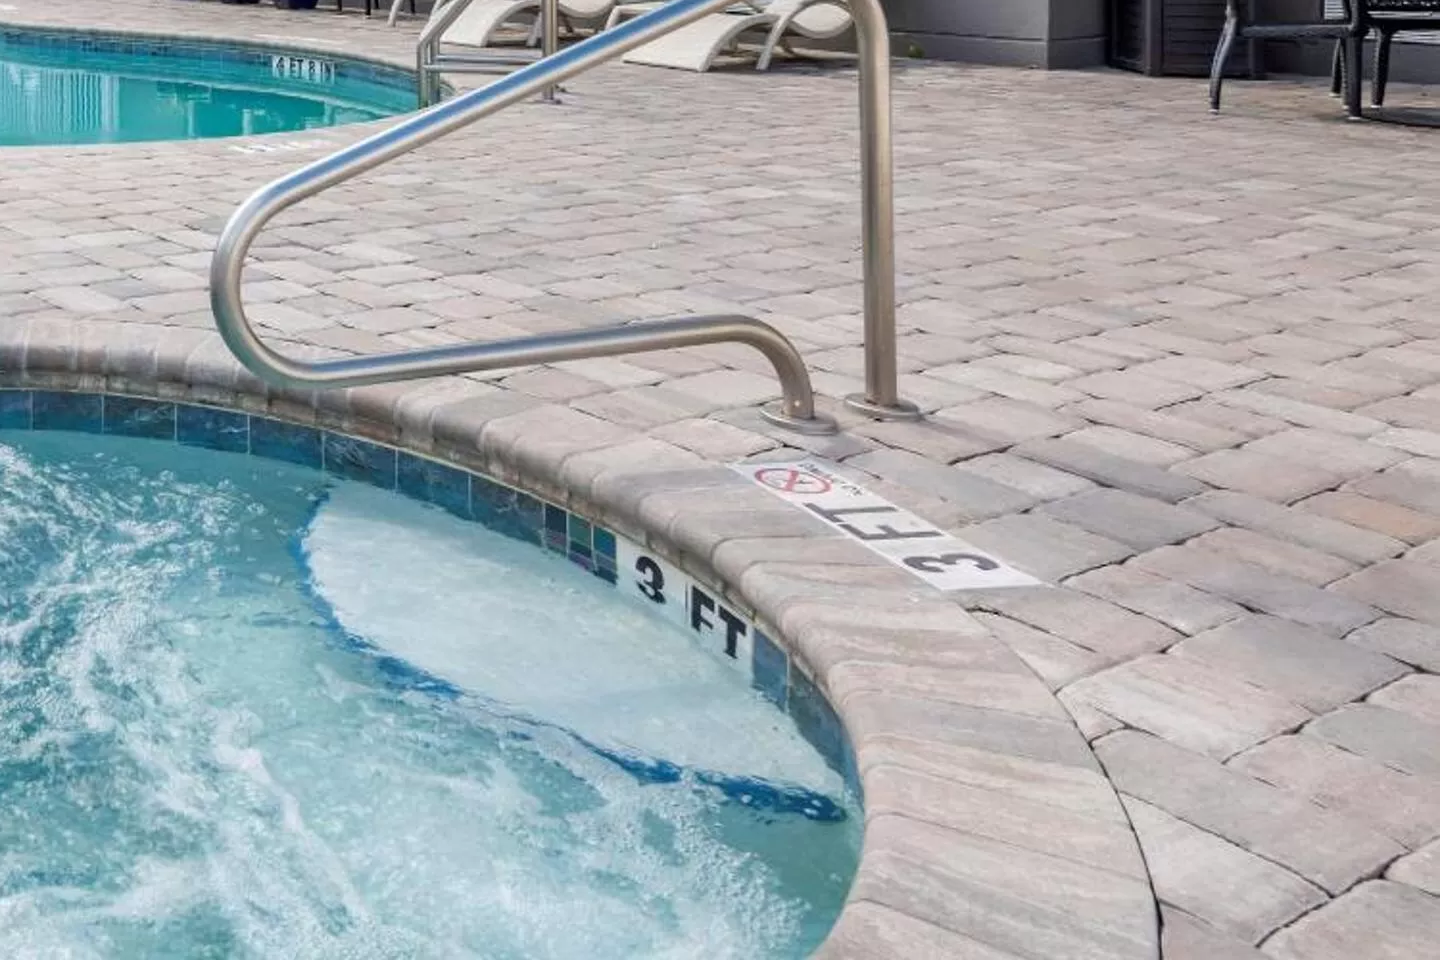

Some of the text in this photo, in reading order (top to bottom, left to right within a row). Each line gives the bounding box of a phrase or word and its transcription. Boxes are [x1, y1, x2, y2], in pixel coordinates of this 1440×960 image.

[802, 502, 1000, 573] 3 FT
[635, 556, 747, 659] 3 FT
